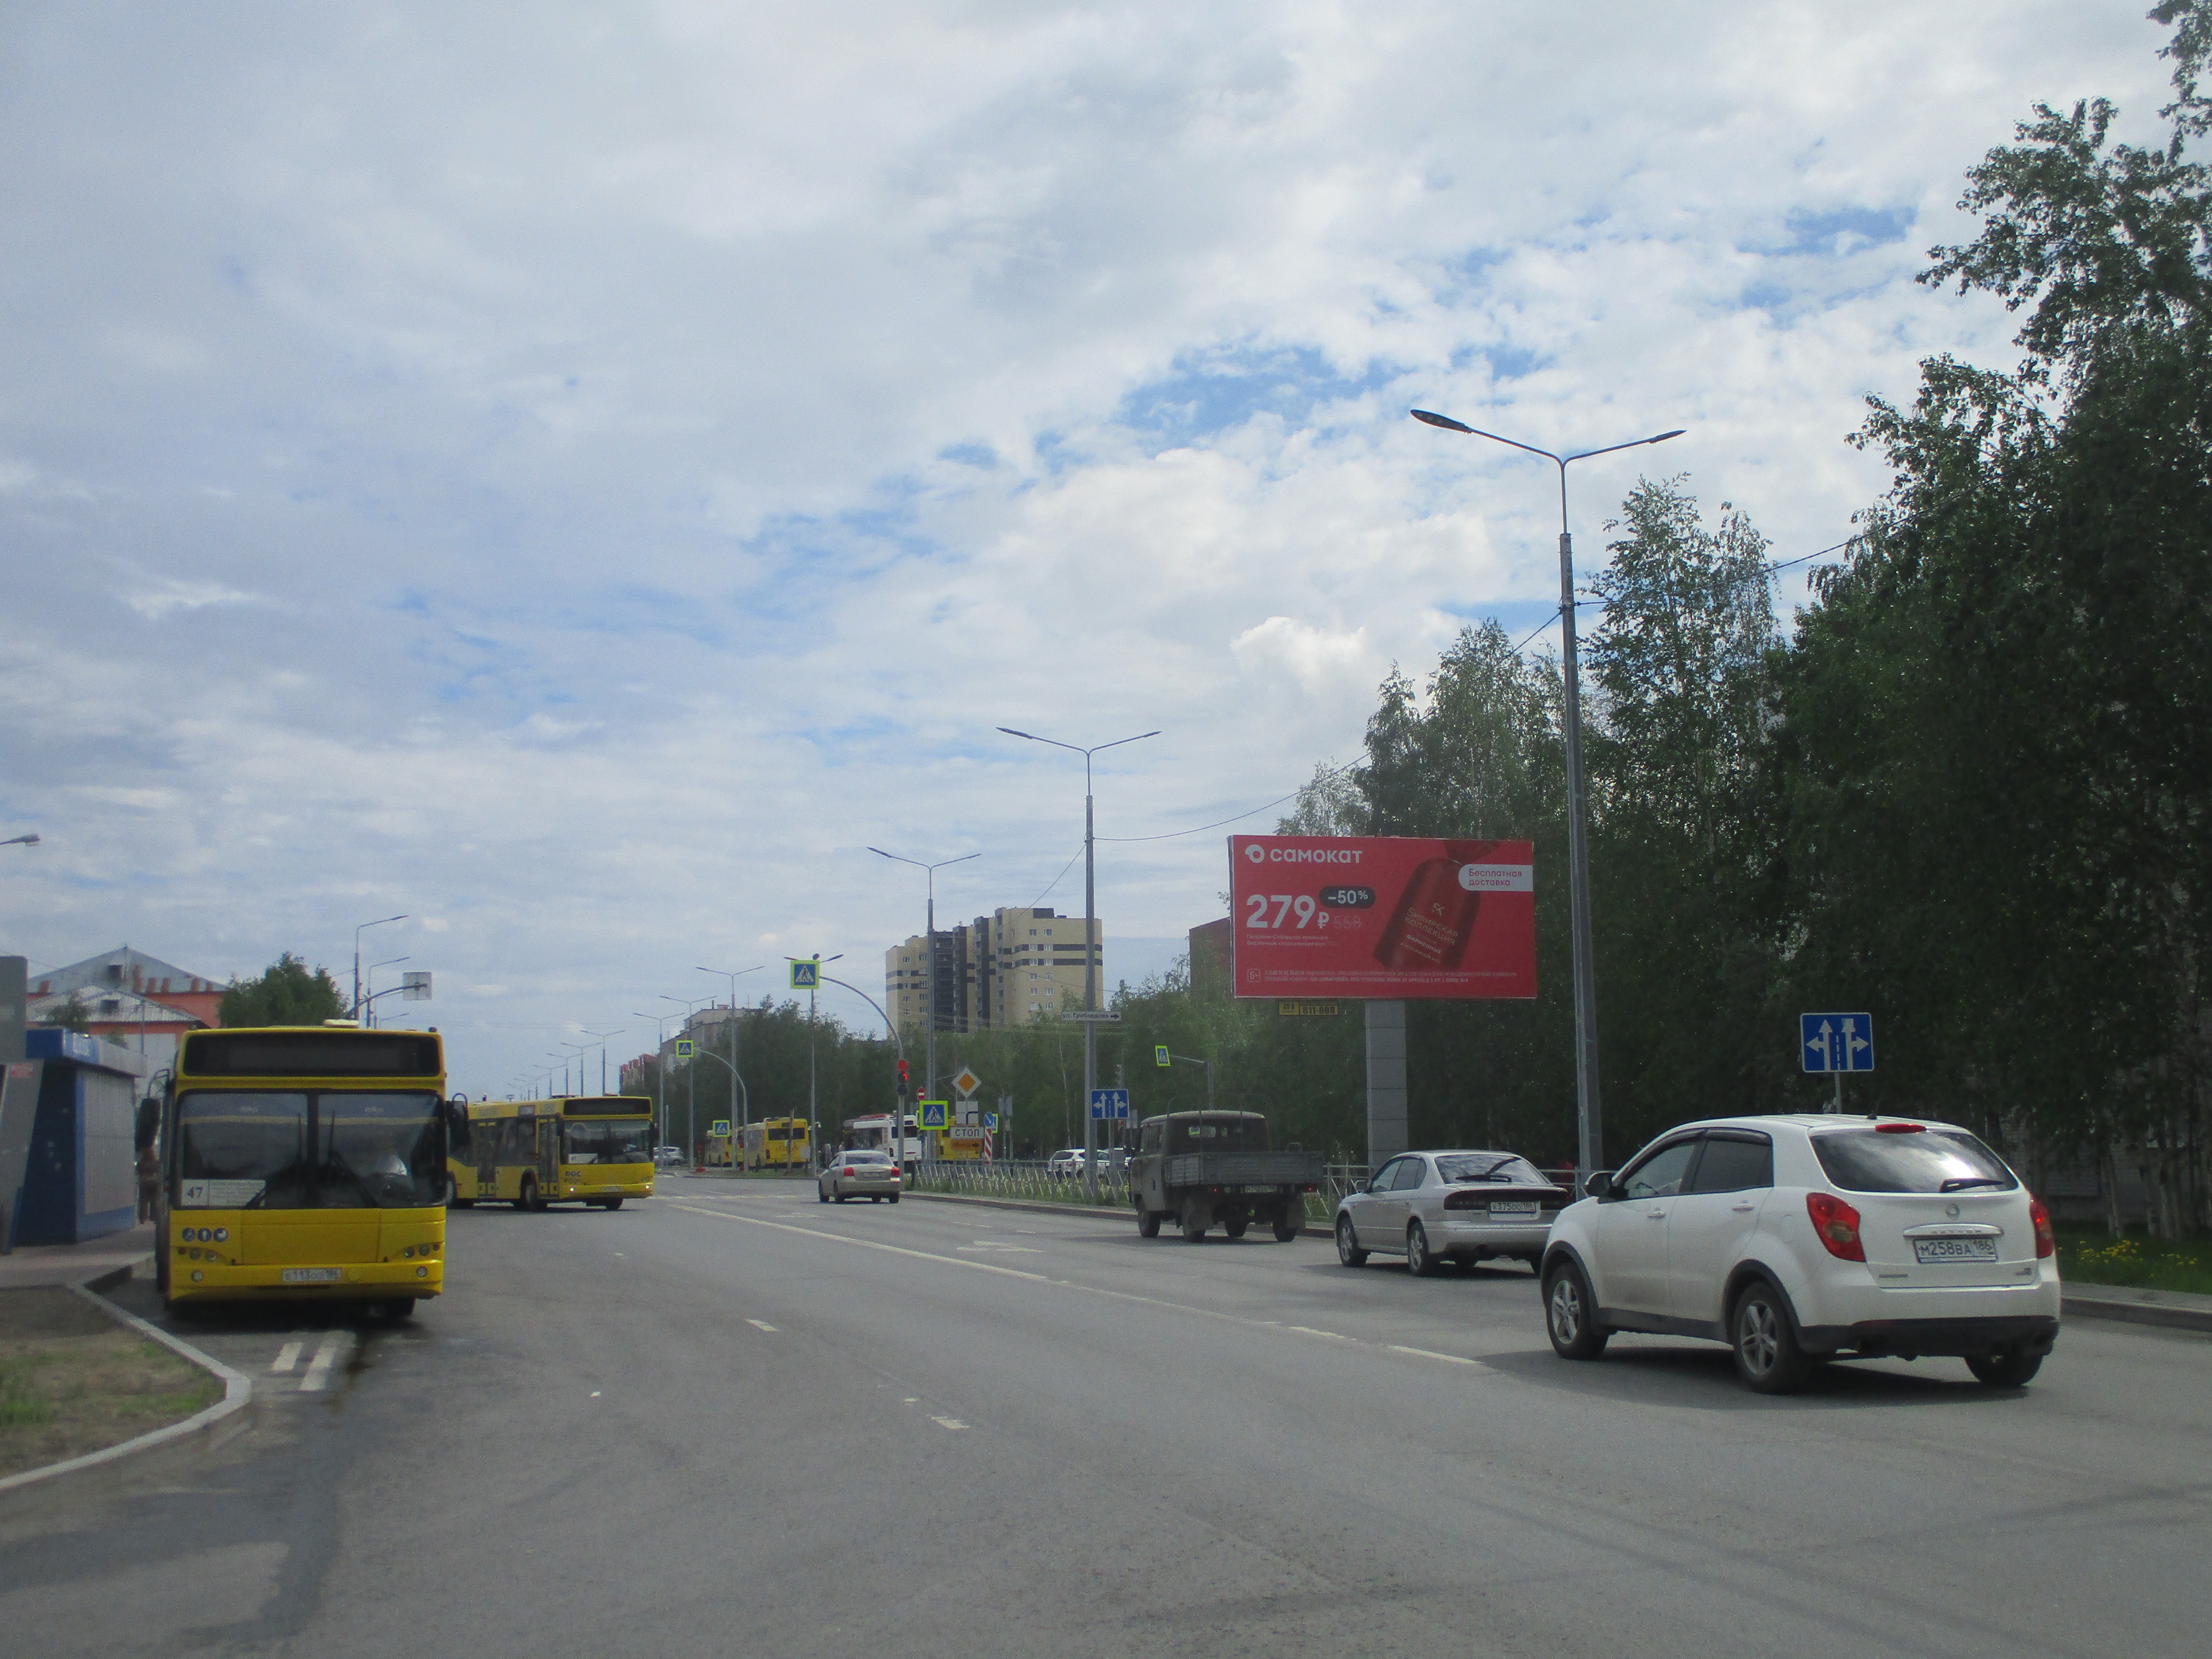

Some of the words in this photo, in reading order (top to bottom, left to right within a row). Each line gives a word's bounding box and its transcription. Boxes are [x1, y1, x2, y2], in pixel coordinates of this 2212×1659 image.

[1270, 848, 1363, 863] самокат
[1469, 868, 1522, 877] Бесплатная
[187, 1186, 204, 1198] 47
